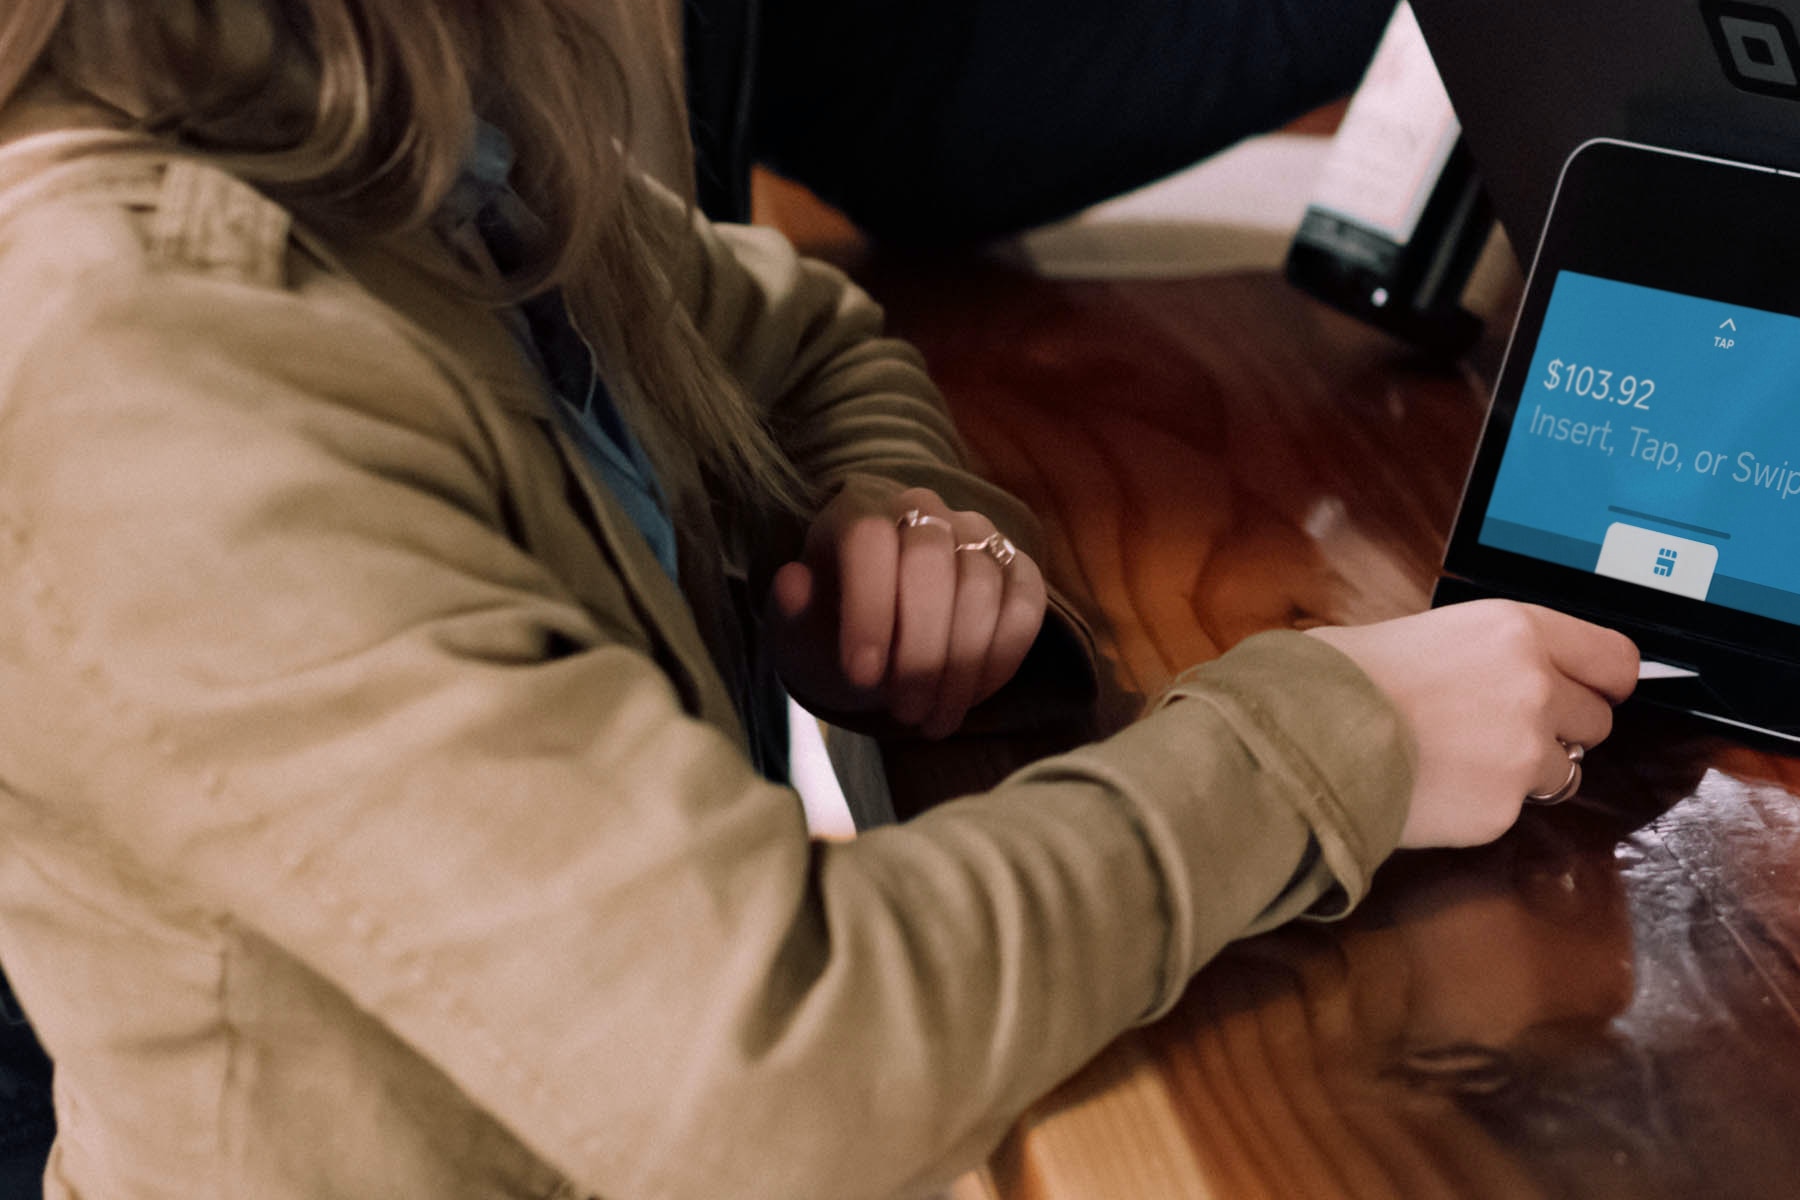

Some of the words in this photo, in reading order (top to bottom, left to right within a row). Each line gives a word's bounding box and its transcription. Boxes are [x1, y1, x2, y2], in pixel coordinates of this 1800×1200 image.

[1713, 336, 1735, 350] TAP
[1543, 358, 1656, 411] $103.92
[1529, 404, 1614, 457] Insert,
[1630, 425, 1683, 473] Tap,
[1694, 450, 1728, 476] or
